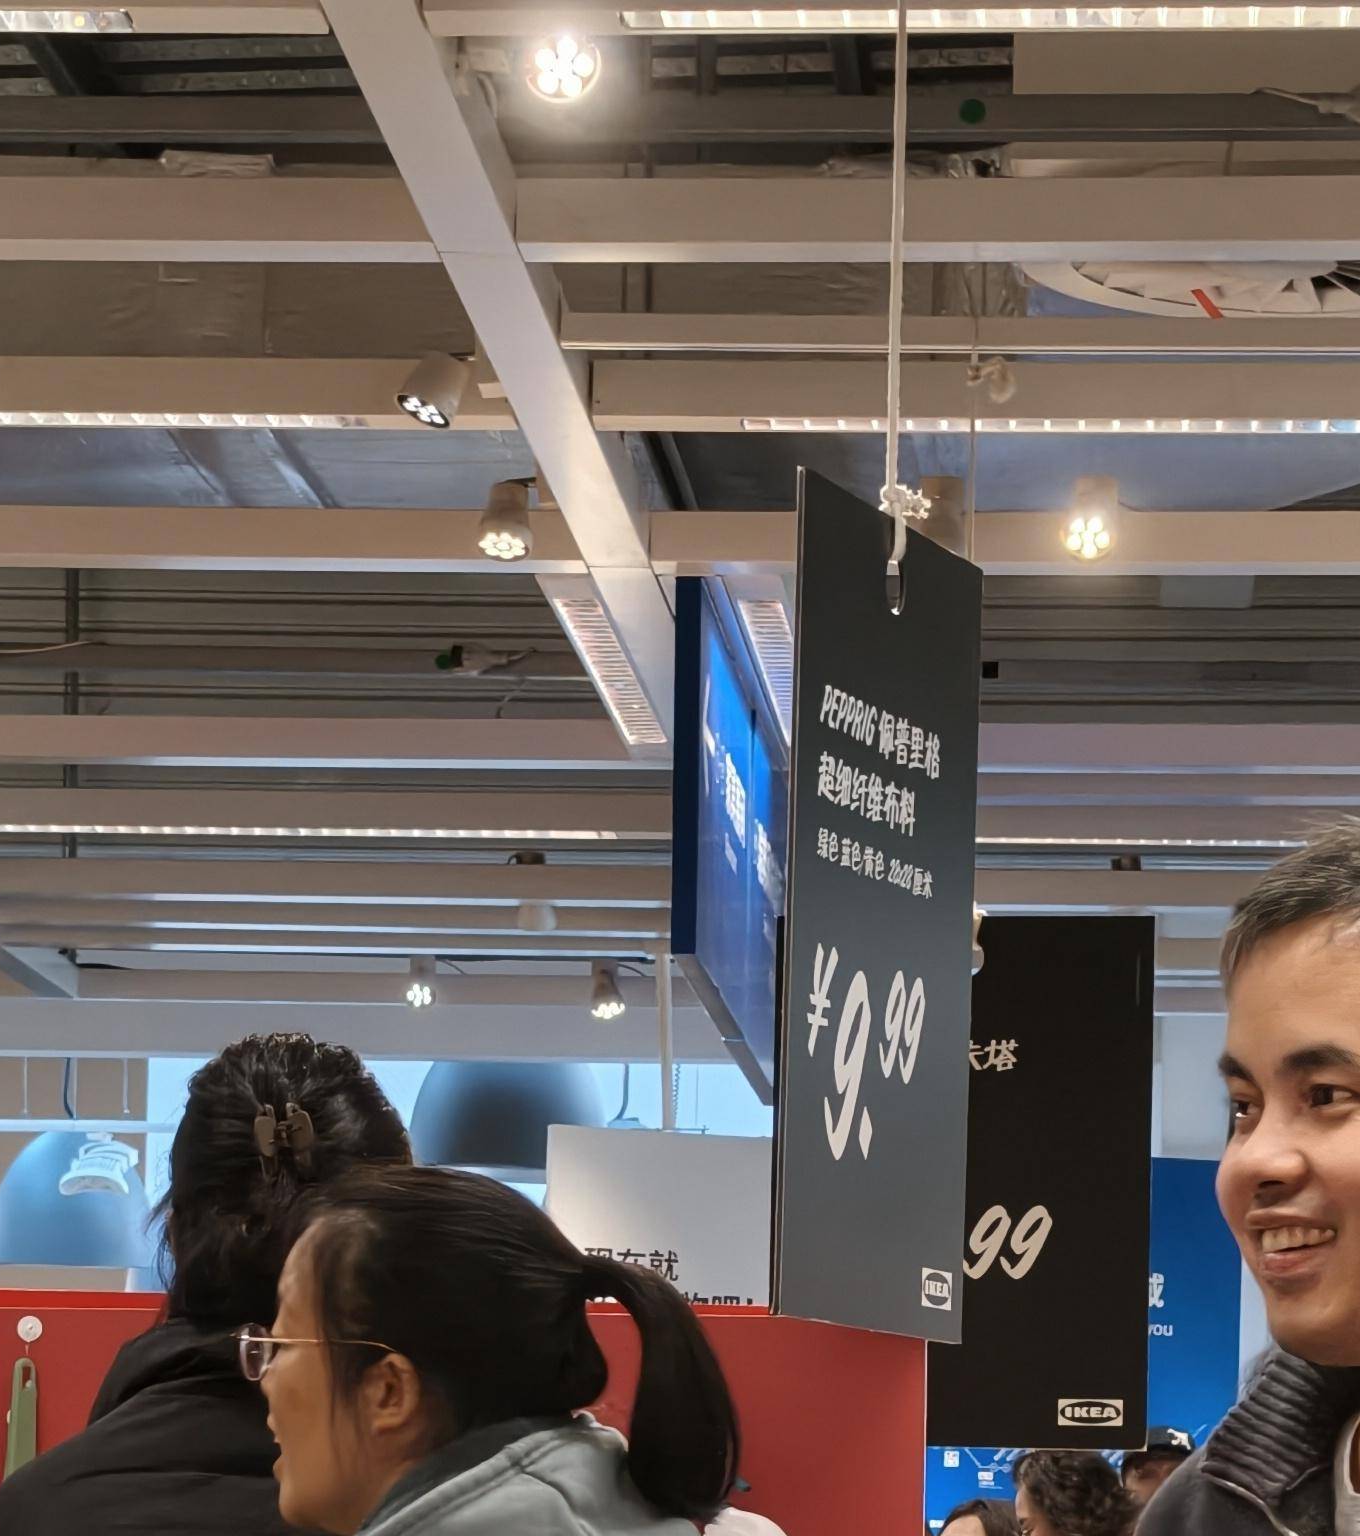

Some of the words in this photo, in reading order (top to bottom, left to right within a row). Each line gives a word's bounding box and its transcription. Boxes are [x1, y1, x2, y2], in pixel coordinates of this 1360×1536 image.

[820, 685, 878, 746] PEPPRIG
[879, 710, 940, 779] 佩普里格
[818, 751, 915, 836] 超细纤维布料
